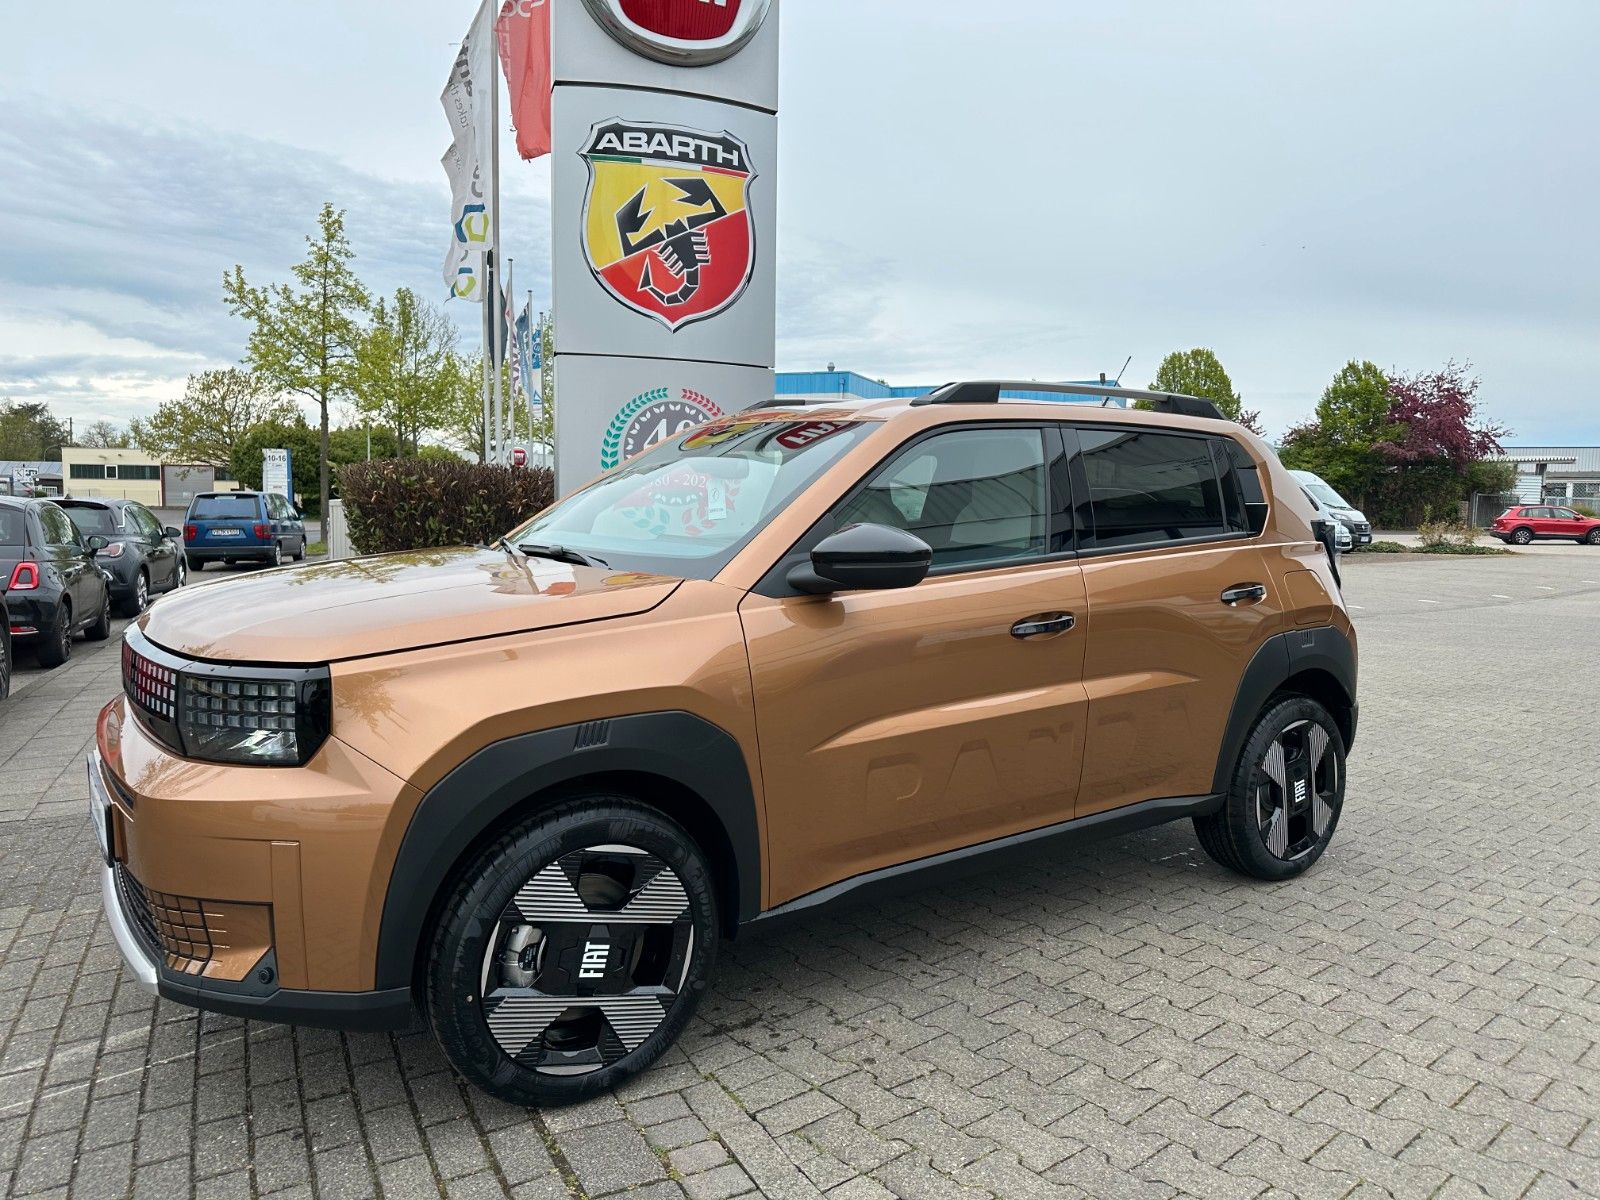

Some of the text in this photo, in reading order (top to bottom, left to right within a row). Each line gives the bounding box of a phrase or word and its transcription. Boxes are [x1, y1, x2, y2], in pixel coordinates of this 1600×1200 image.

[595, 132, 739, 166] ABARTH
[268, 454, 287, 462] 10-16
[1294, 779, 1306, 803] FIAT
[578, 941, 610, 978] FIAT
